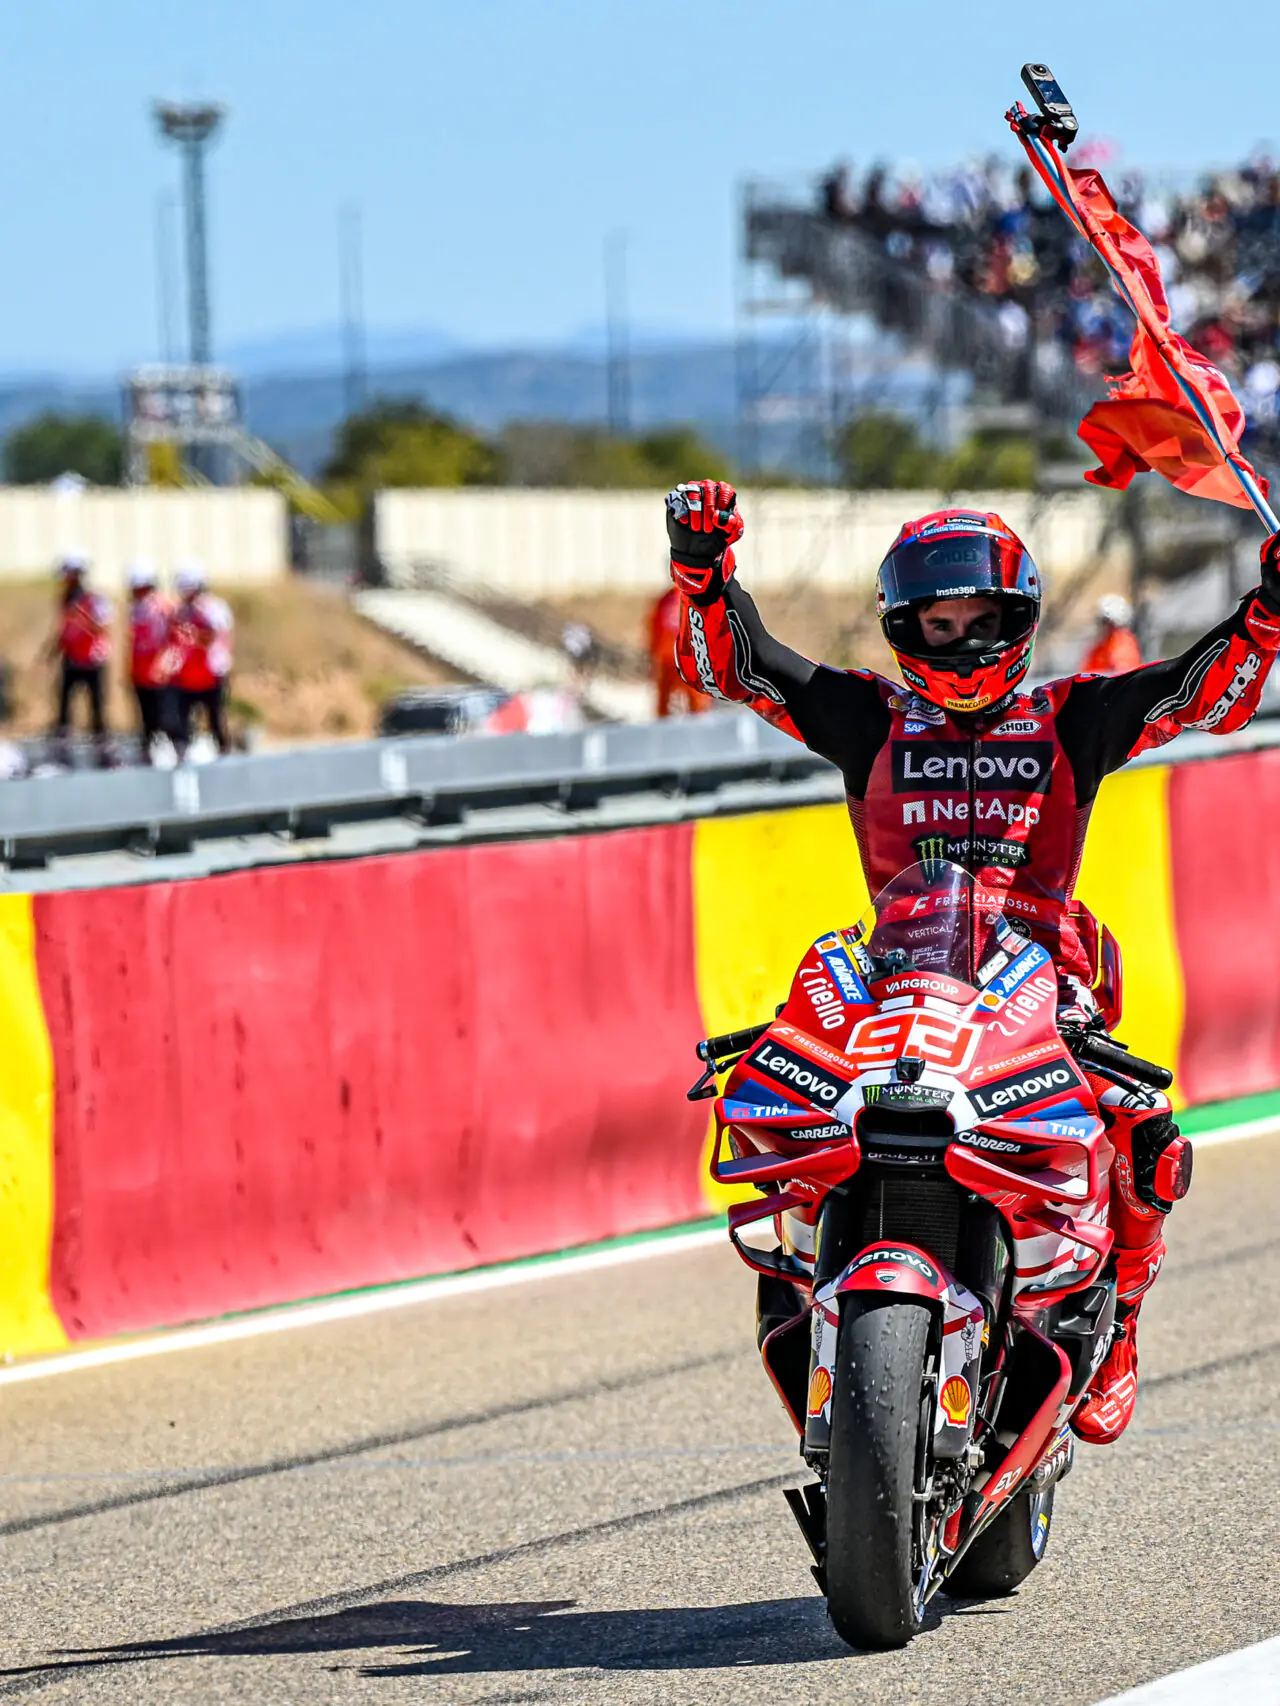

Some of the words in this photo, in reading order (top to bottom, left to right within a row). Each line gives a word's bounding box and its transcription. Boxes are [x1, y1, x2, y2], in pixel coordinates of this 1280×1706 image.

[936, 586, 976, 597] Insta360
[904, 723, 926, 733] SAP
[999, 722, 1034, 732] SHOEI
[903, 751, 1041, 779] Lenovo
[932, 798, 1041, 828] NetApp
[947, 839, 1027, 860] MONSTER
[935, 893, 1038, 915] FRECCIAROSSA
[907, 925, 952, 939] VERTICAL
[826, 955, 863, 1001] ADVANCE
[1000, 946, 1045, 993] ADVANCE
[885, 978, 960, 997] VARGROUP
[803, 976, 846, 1030] riello
[1004, 977, 1058, 1026] riello
[793, 1034, 855, 1070] FRECCIAROSSA
[988, 1043, 1061, 1072] FRECCIAROSSA
[755, 1046, 838, 1101] Lenovo
[881, 1085, 951, 1102] MONSTER
[974, 1069, 1070, 1113] Lenovo
[753, 1103, 789, 1117] TIM
[790, 1124, 848, 1139] CARRERA
[1050, 1122, 1087, 1138] TIM
[958, 1132, 1021, 1153] CARRERA
[847, 1250, 933, 1278] Lenovo
